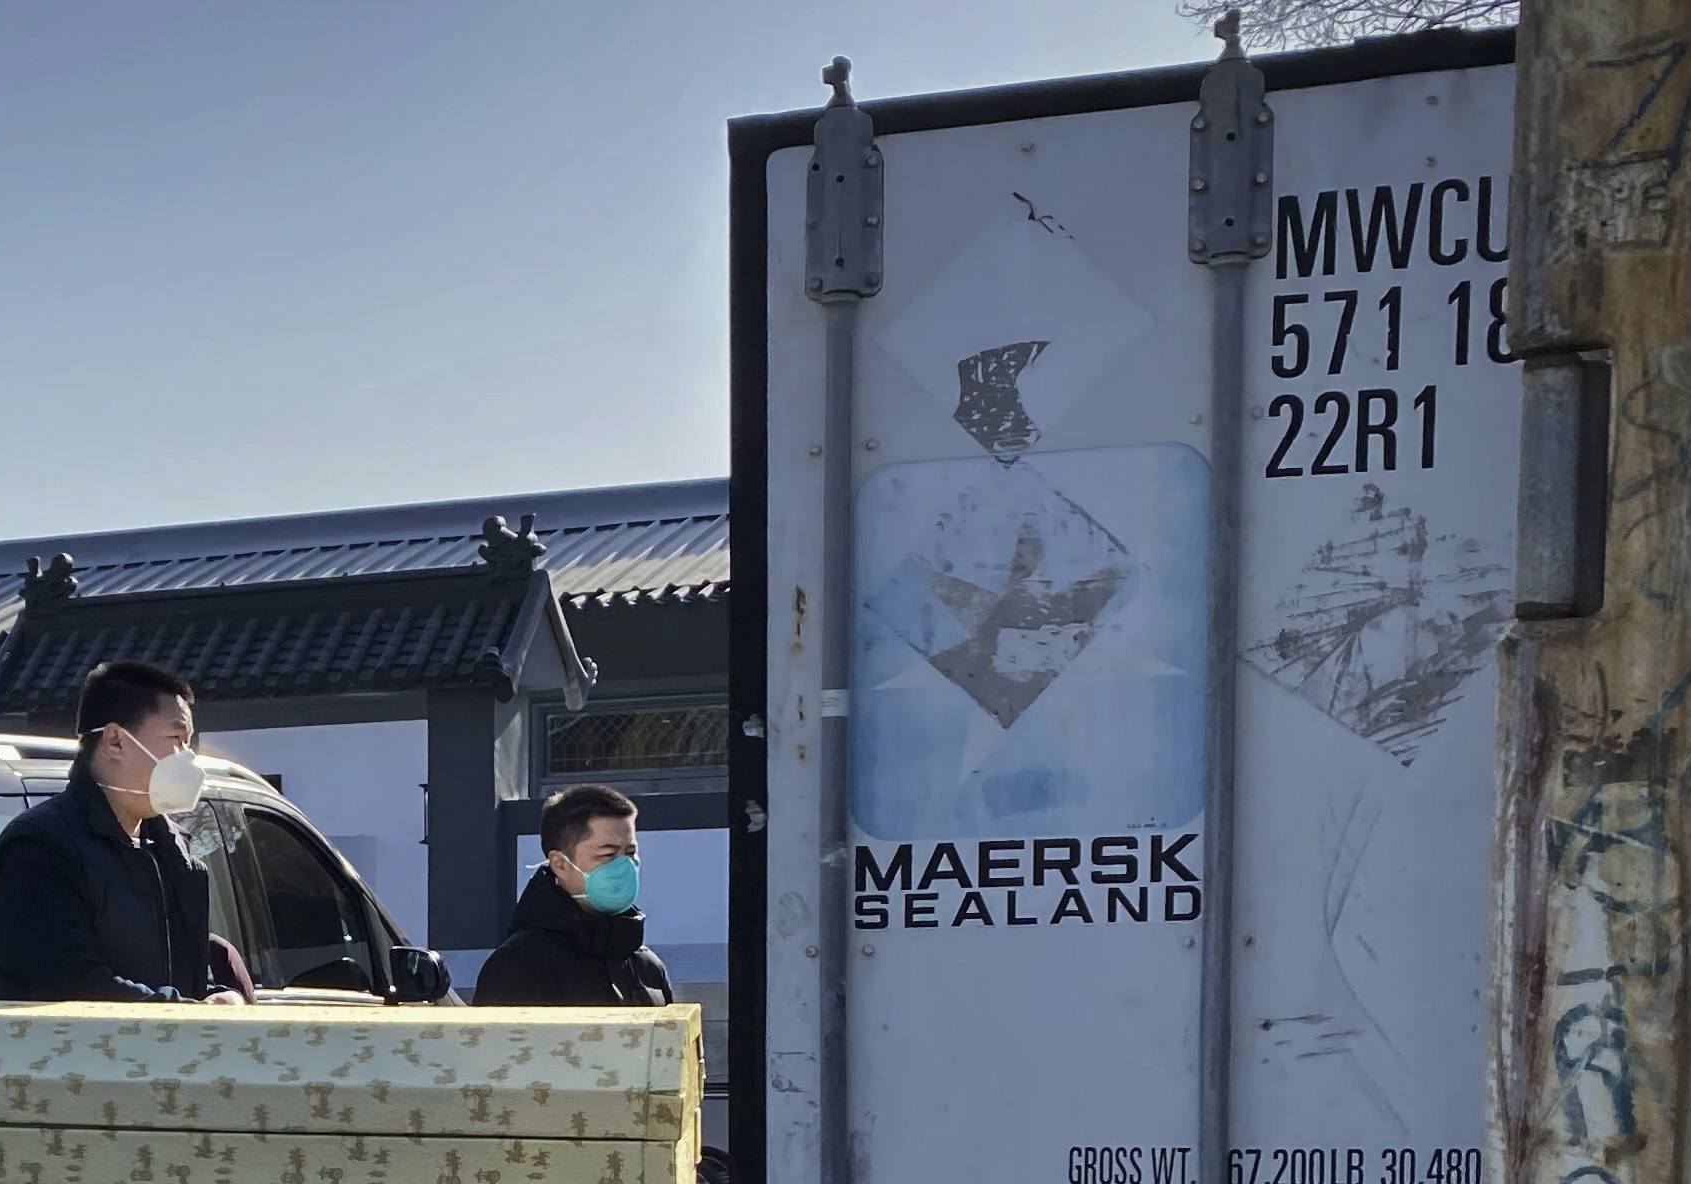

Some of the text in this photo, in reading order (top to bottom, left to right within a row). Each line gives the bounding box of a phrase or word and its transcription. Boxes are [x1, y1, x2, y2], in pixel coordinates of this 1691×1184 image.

[1276, 175, 1510, 280] MWCU
[1271, 285, 1403, 378] 571
[1265, 384, 1437, 479] 22R1
[854, 833, 1201, 894] MAERSK
[854, 883, 1202, 930] SEALAND
